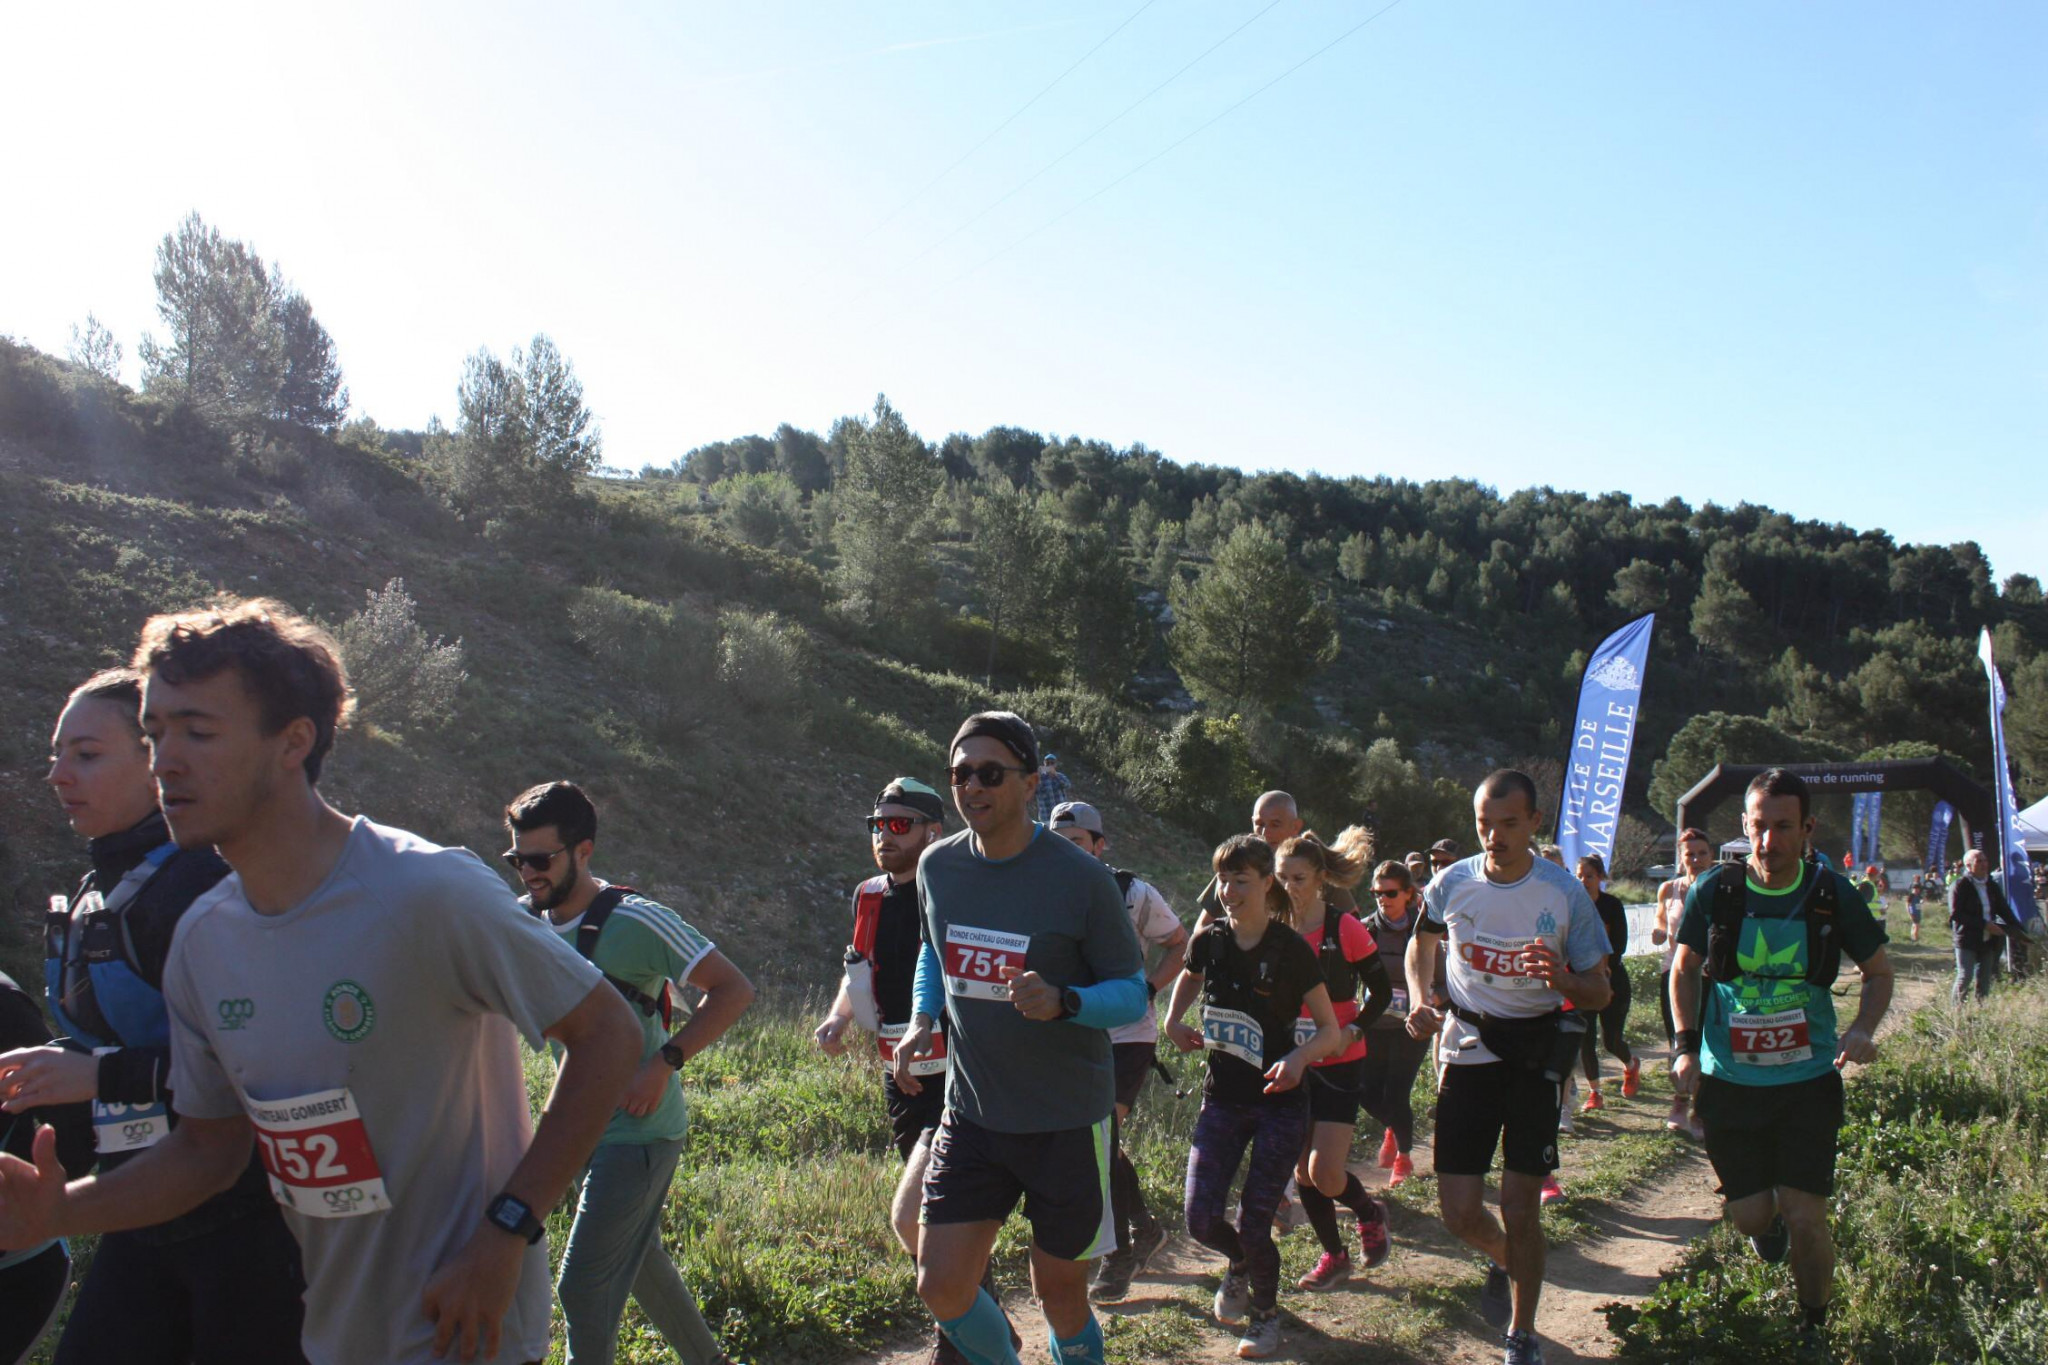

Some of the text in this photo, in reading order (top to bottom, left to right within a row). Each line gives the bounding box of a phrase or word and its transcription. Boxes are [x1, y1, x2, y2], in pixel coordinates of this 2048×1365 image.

[1563, 719, 1598, 837] VILLE DE
[1584, 702, 1634, 858] MARSEILLE
[1823, 773, 1838, 783] de
[1840, 772, 1885, 784] running
[949, 929, 1027, 948] RONDE CHÂTEAU GOMBERT
[957, 948, 1007, 980] 751
[1483, 950, 1528, 973] 756
[1209, 1022, 1261, 1052] 1119
[1741, 1028, 1797, 1050] 732
[290, 1097, 348, 1121] GOMBERT
[257, 1131, 348, 1180] 752
